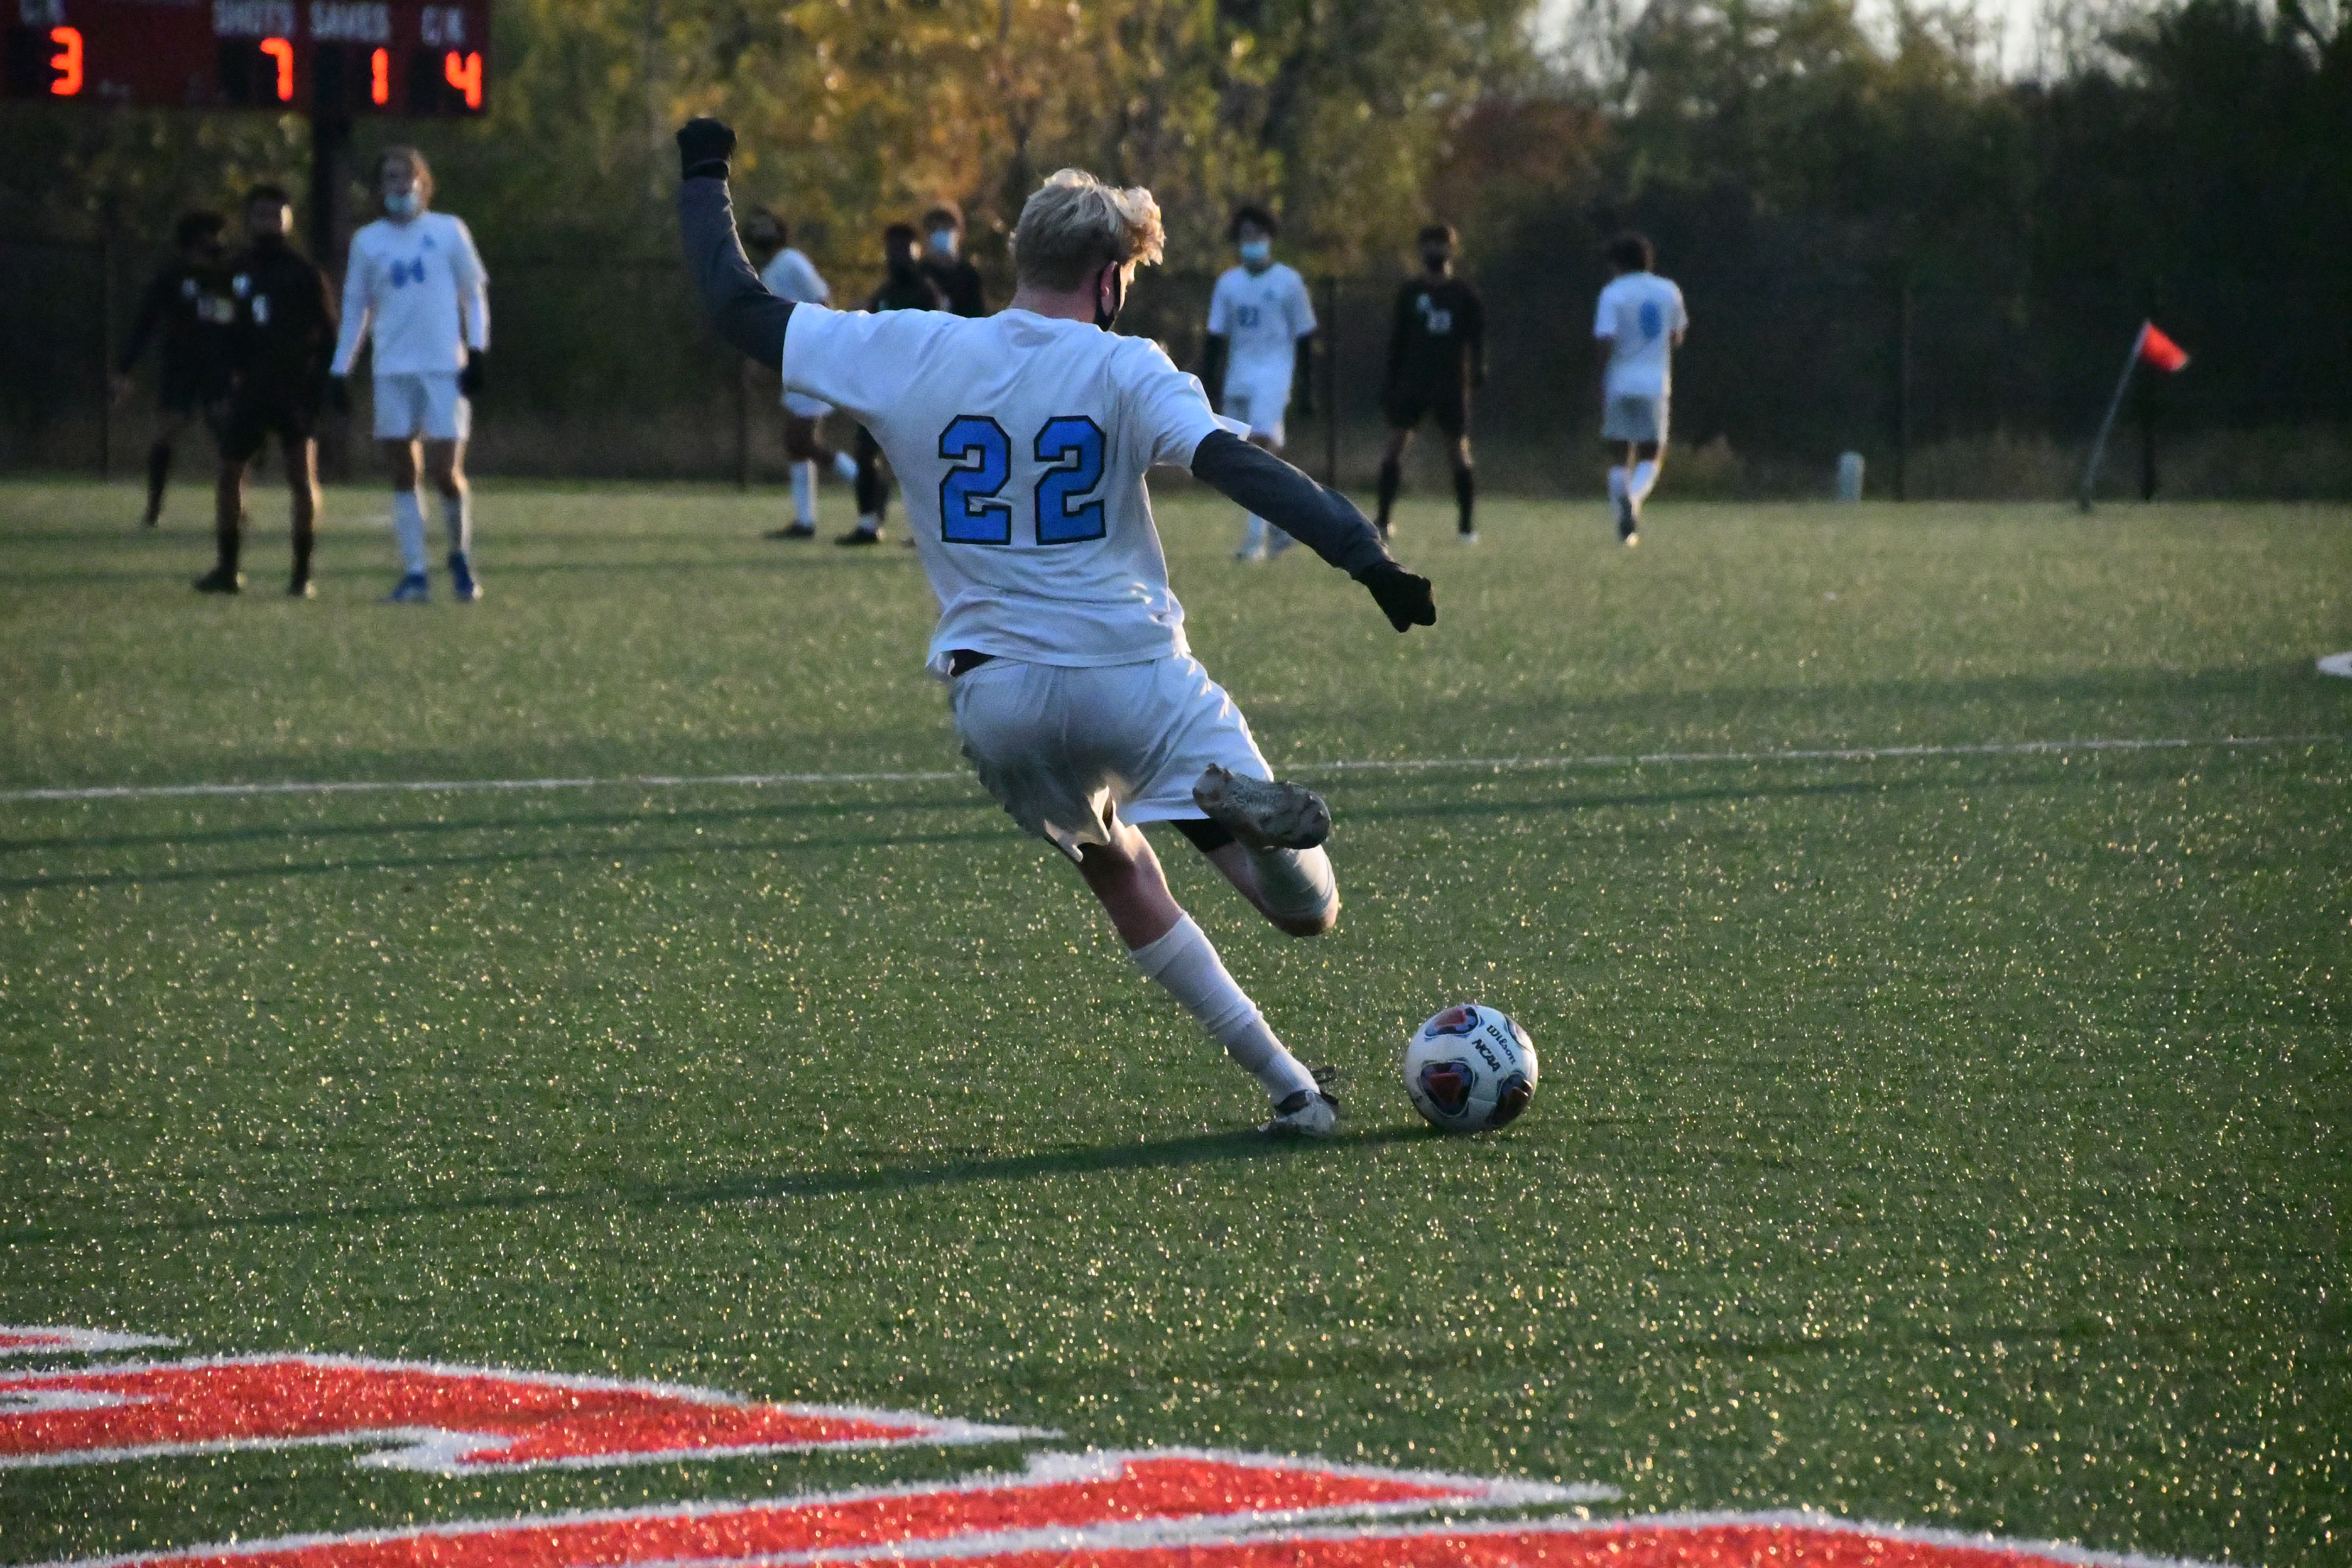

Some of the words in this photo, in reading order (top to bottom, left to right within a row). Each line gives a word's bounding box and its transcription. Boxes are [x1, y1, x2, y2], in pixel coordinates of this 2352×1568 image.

[51, 27, 83, 95] 3
[260, 38, 293, 101] 7
[372, 48, 388, 105] 1
[445, 51, 482, 109] 4
[939, 414, 1107, 545] 22
[1472, 1039, 1500, 1072] NCAA
[1487, 1025, 1516, 1064] Wilson
